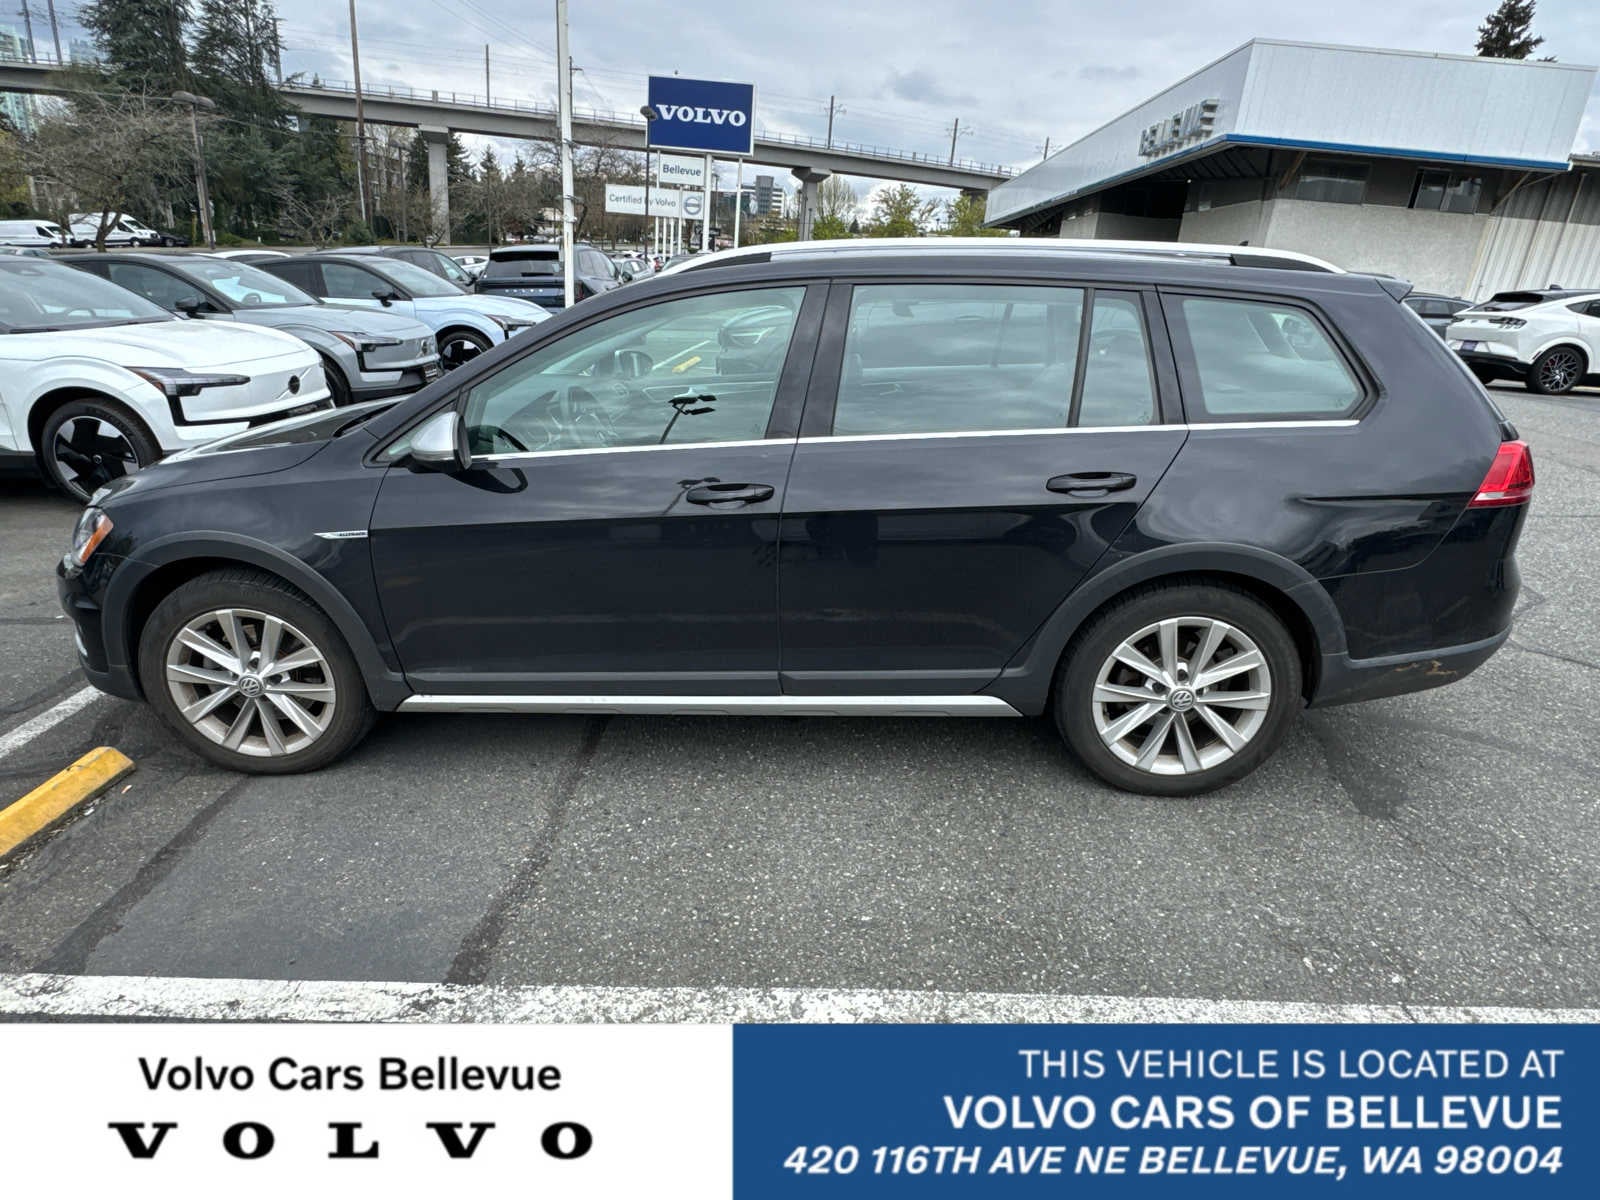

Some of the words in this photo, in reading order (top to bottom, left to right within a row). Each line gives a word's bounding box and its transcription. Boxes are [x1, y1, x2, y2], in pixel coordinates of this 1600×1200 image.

[655, 104, 746, 127] VOLVO
[662, 164, 702, 177] Bellevue
[609, 194, 642, 204] Certified
[655, 198, 676, 207] Volvo
